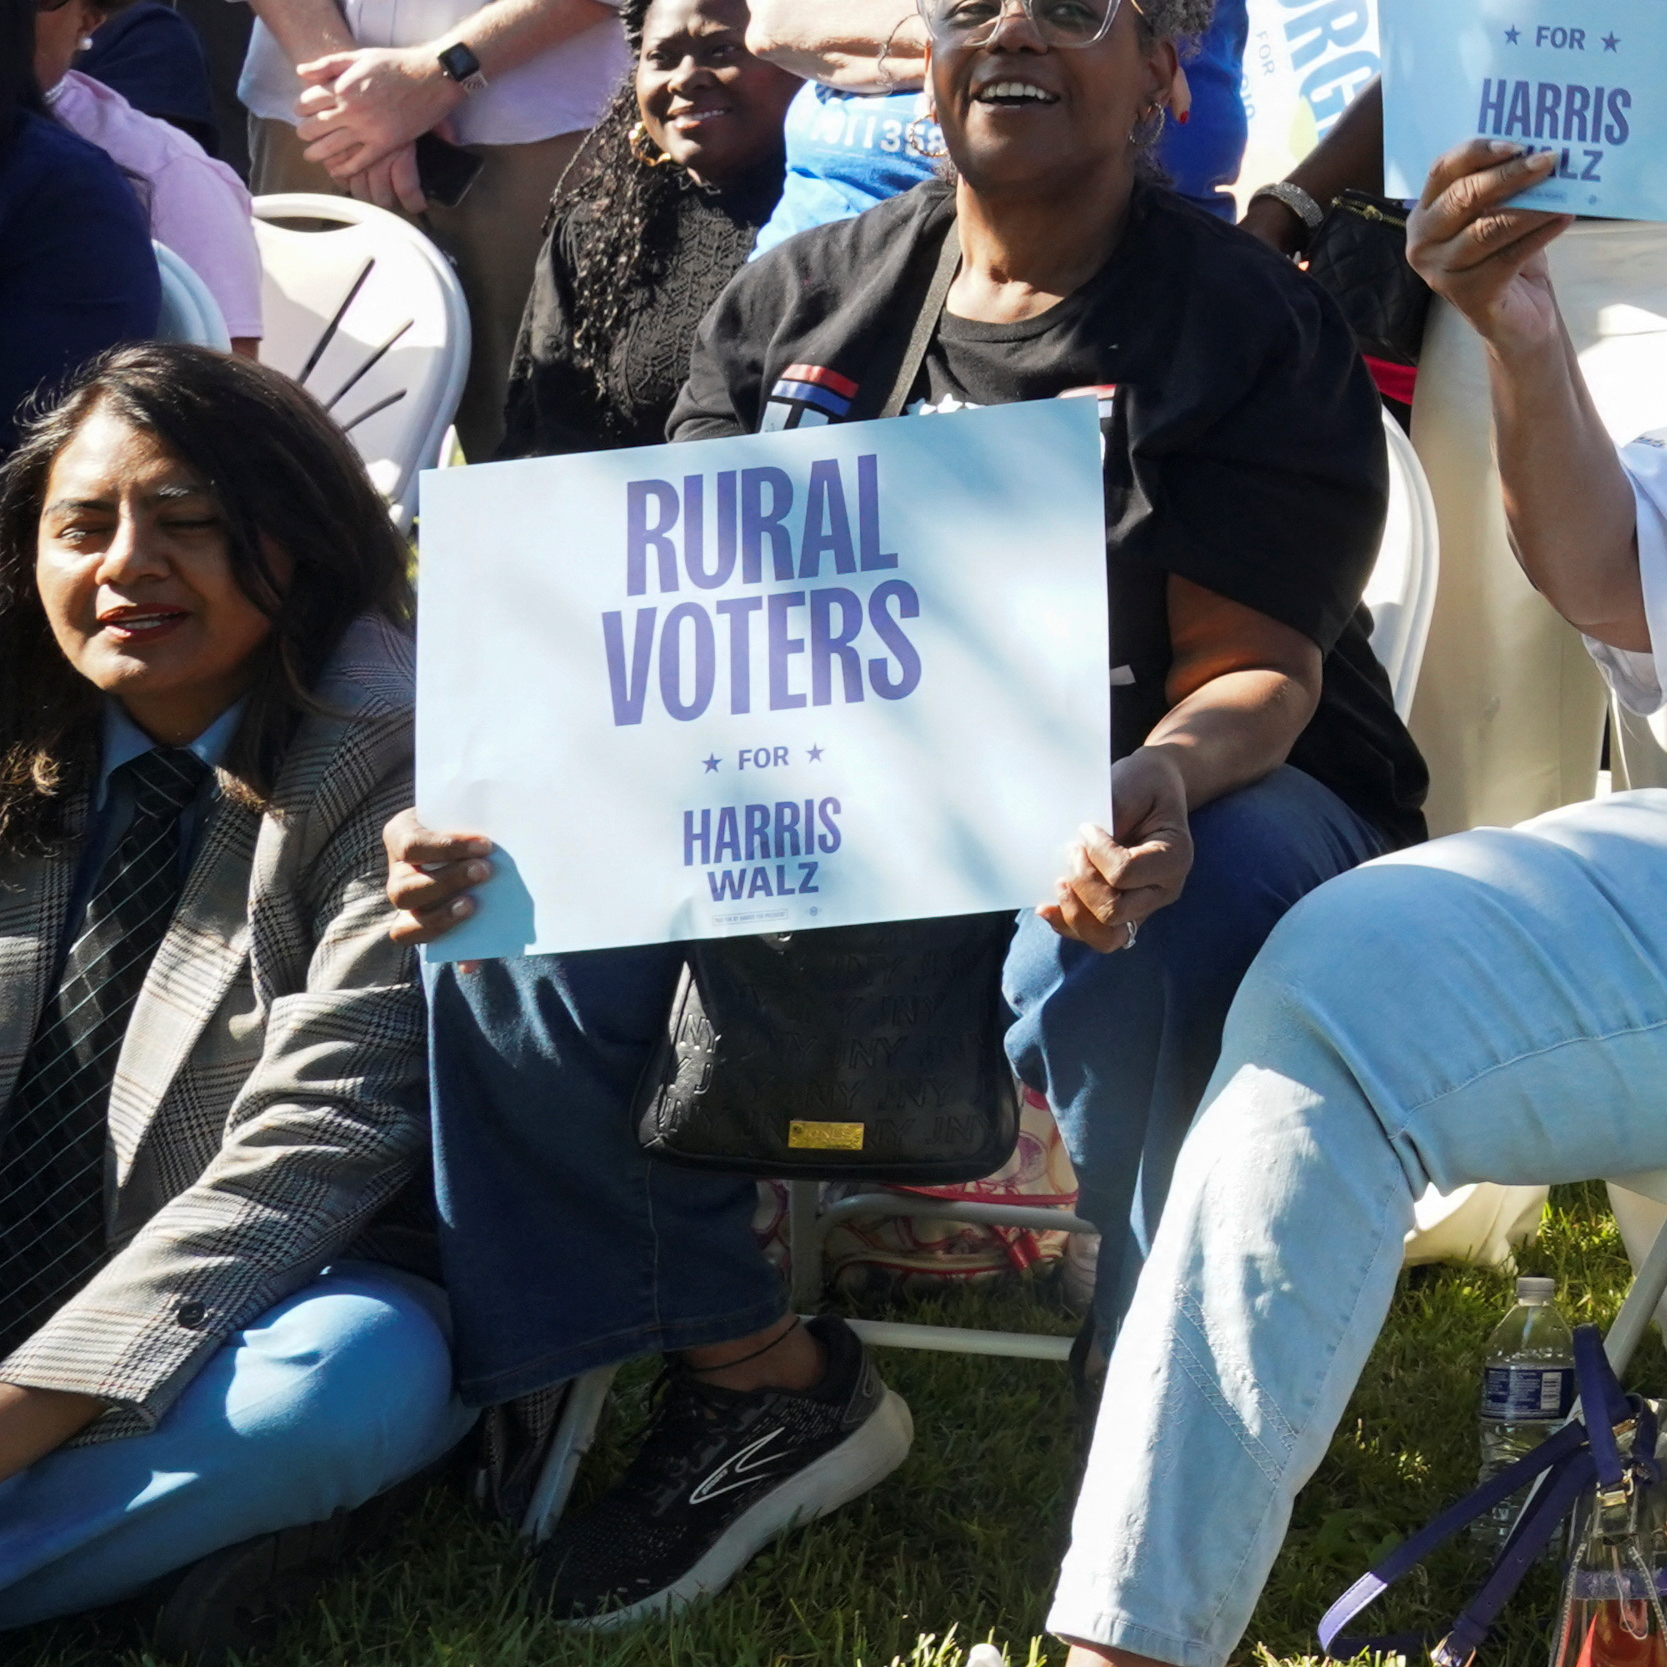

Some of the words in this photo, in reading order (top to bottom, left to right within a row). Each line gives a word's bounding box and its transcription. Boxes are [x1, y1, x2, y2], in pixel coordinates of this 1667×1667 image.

[1535, 25, 1586, 51] FOR
[1477, 77, 1633, 146] HARRIS
[626, 453, 899, 597] RURAL
[601, 578, 923, 727] VOTERS
[737, 745, 790, 771] FOR
[683, 796, 842, 867] HARRIS
[706, 861, 820, 903] WALZ
